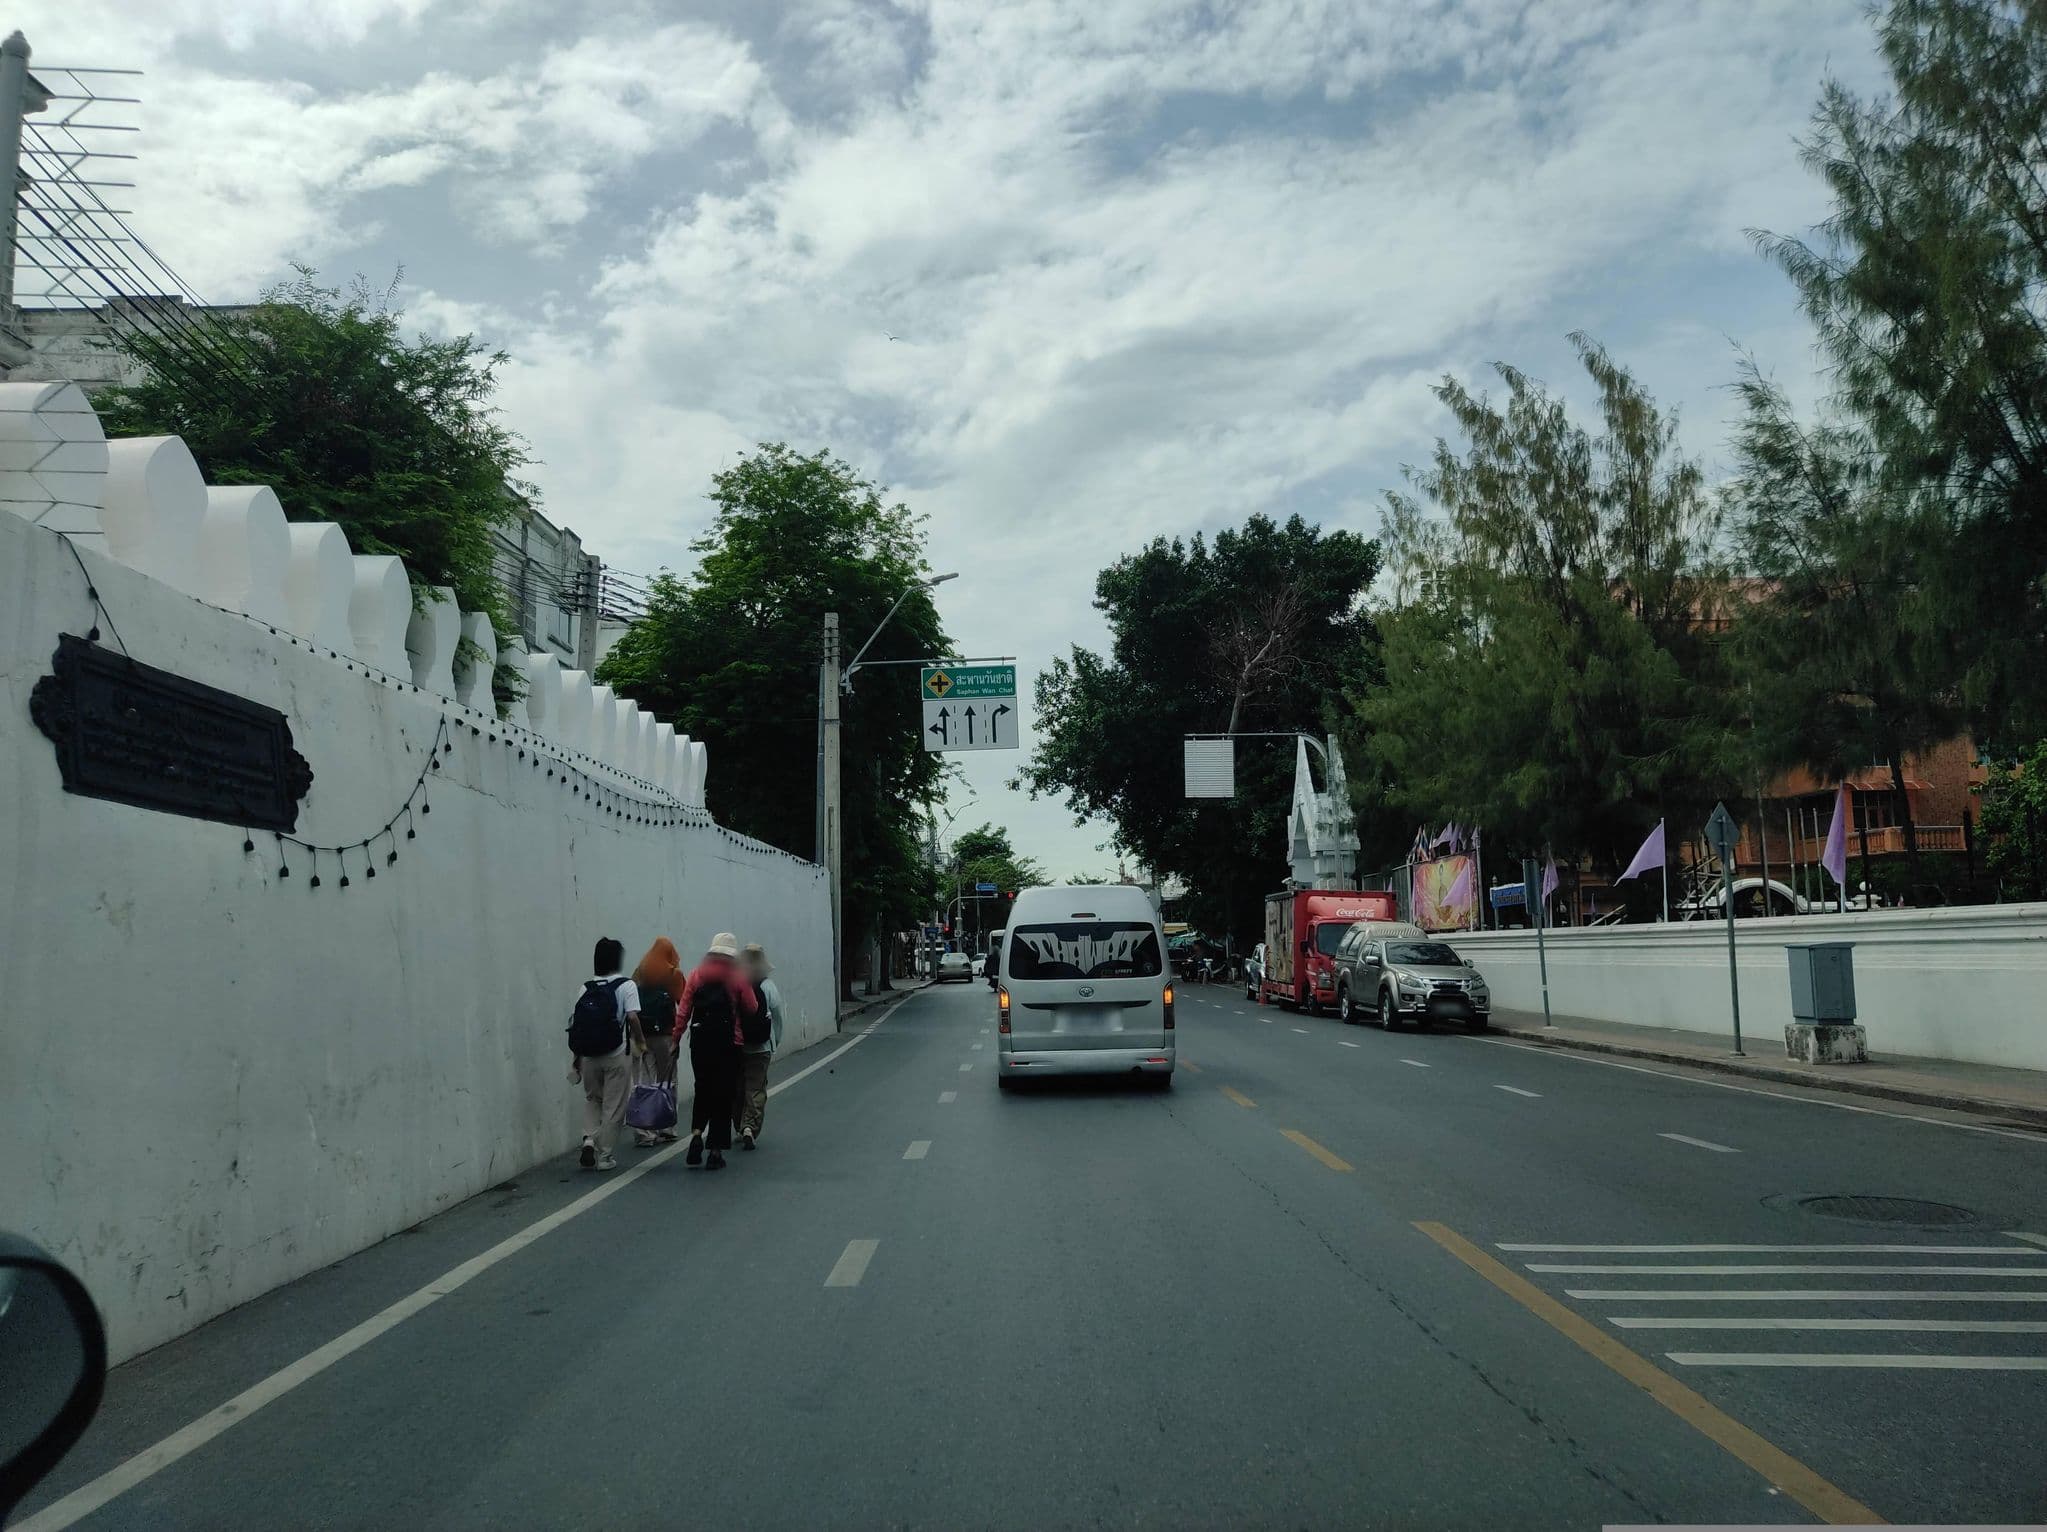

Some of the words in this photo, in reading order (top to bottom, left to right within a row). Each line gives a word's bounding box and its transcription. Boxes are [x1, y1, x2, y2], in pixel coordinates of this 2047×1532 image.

[956, 670, 1013, 685] สะพานวันชาติ
[1016, 930, 1154, 975] THAWAT
